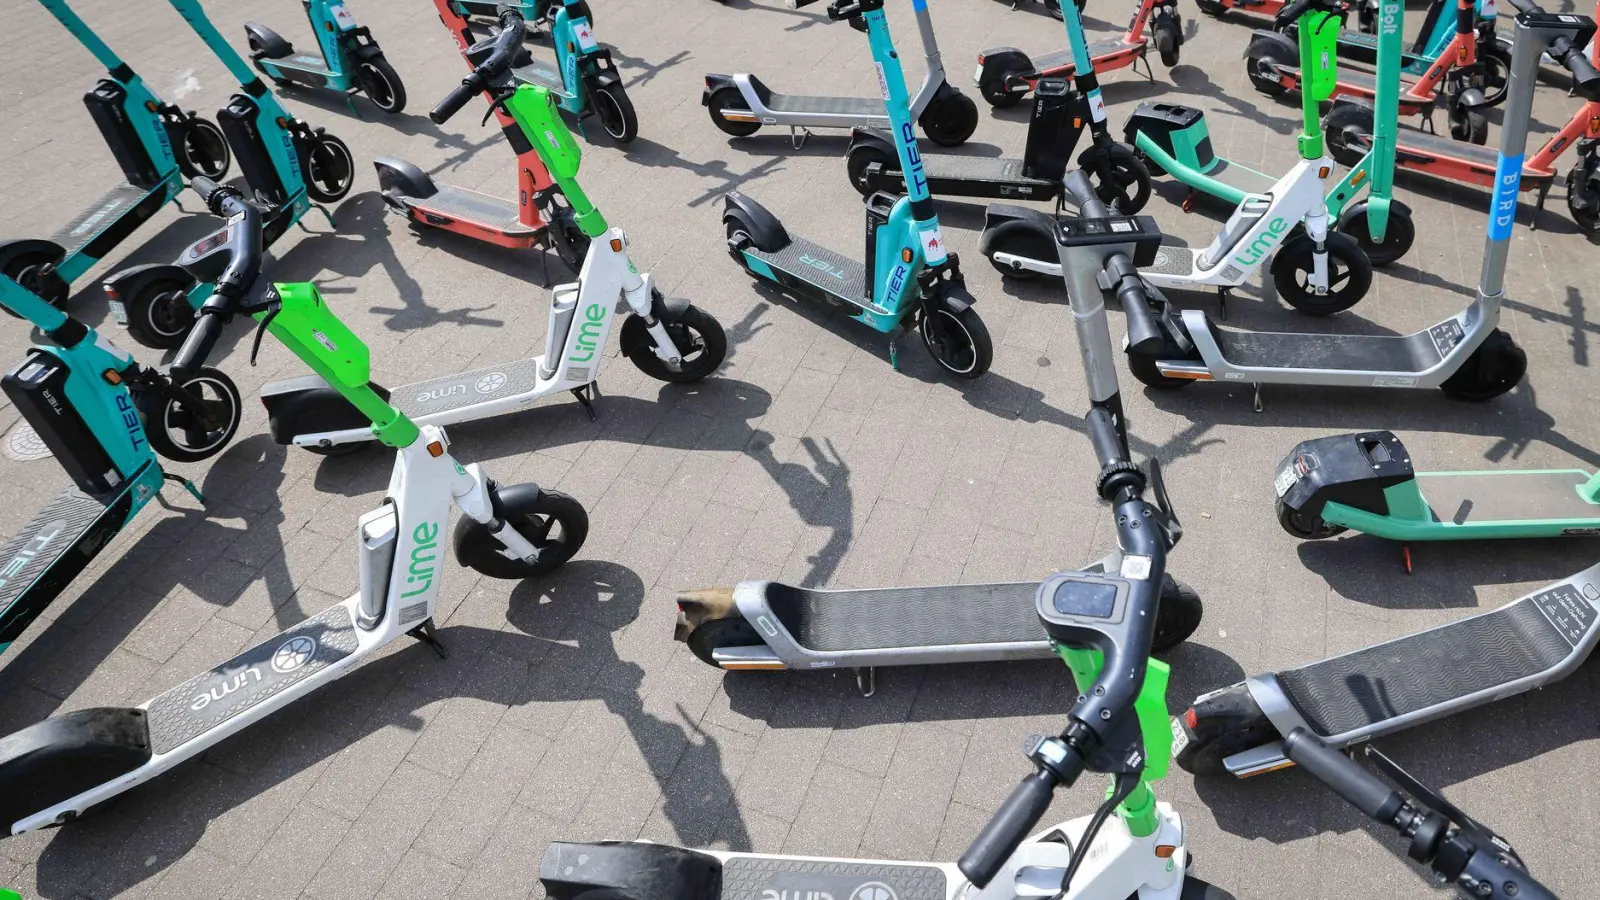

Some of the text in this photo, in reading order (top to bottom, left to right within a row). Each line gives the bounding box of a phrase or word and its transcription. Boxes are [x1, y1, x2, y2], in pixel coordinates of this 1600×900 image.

[1383, 4, 1399, 34] Bolt
[567, 56, 577, 88] TIER
[1036, 100, 1044, 118] TIER
[152, 120, 172, 161] TIER
[282, 135, 300, 178] TIER
[902, 122, 927, 195] TIER
[1497, 172, 1518, 227] BIRD
[1235, 216, 1288, 266] Lime
[799, 253, 844, 279] TIER
[887, 265, 906, 303] TIER
[569, 303, 607, 362] Lime
[42, 389, 62, 415] TIER
[417, 384, 467, 402] Lime
[115, 392, 144, 452] TIER
[0, 529, 60, 588] TIE
[400, 521, 439, 599] Lime
[191, 667, 262, 711] Lime
